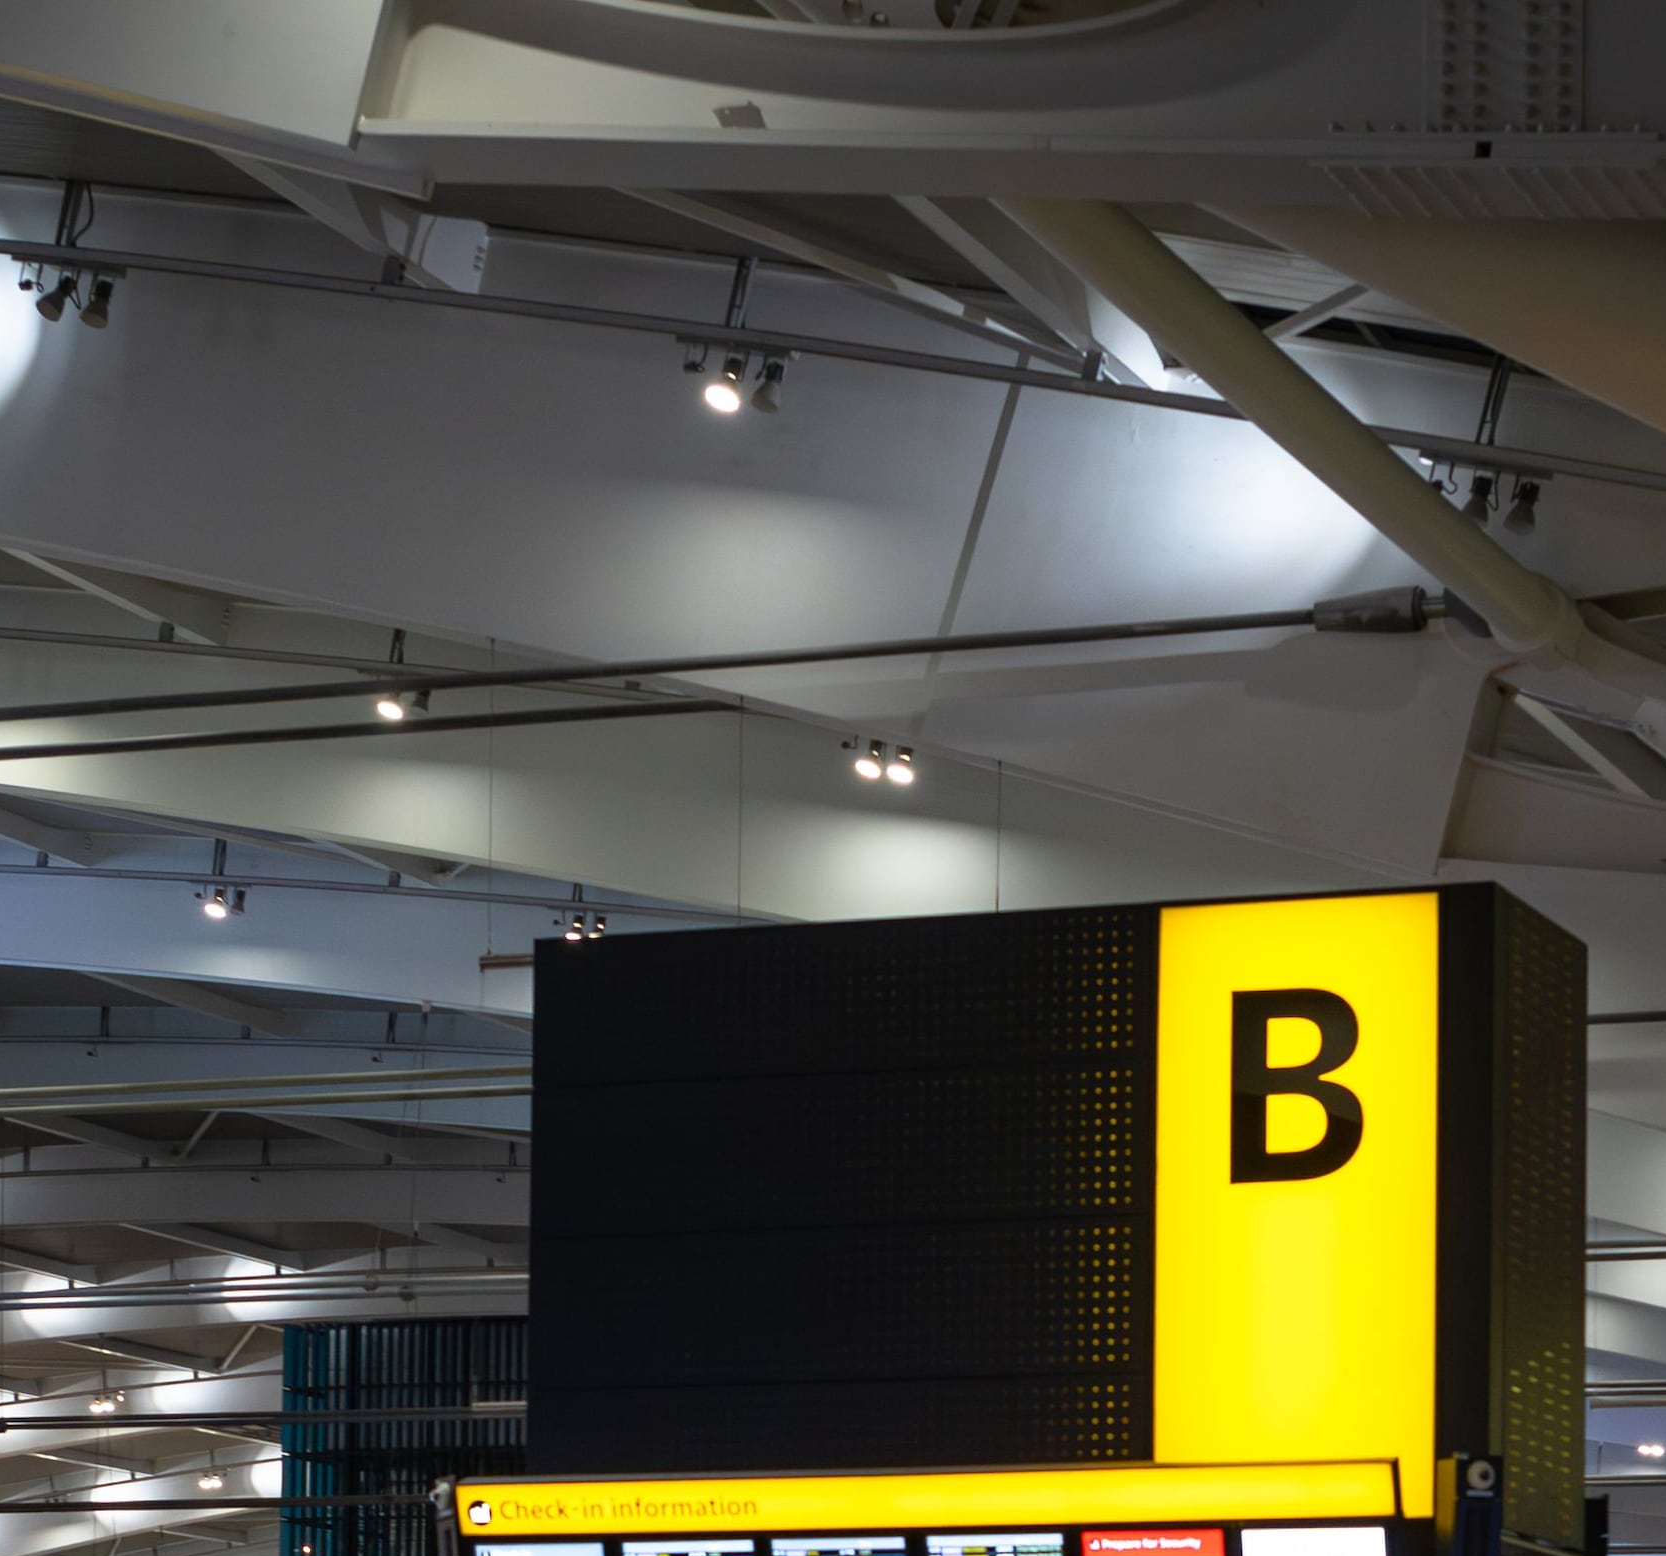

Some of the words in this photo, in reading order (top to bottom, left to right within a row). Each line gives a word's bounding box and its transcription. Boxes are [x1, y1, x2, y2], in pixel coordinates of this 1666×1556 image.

[1230, 987, 1364, 1184] B
[499, 1497, 604, 1521] Check-in
[612, 1495, 758, 1519] information
